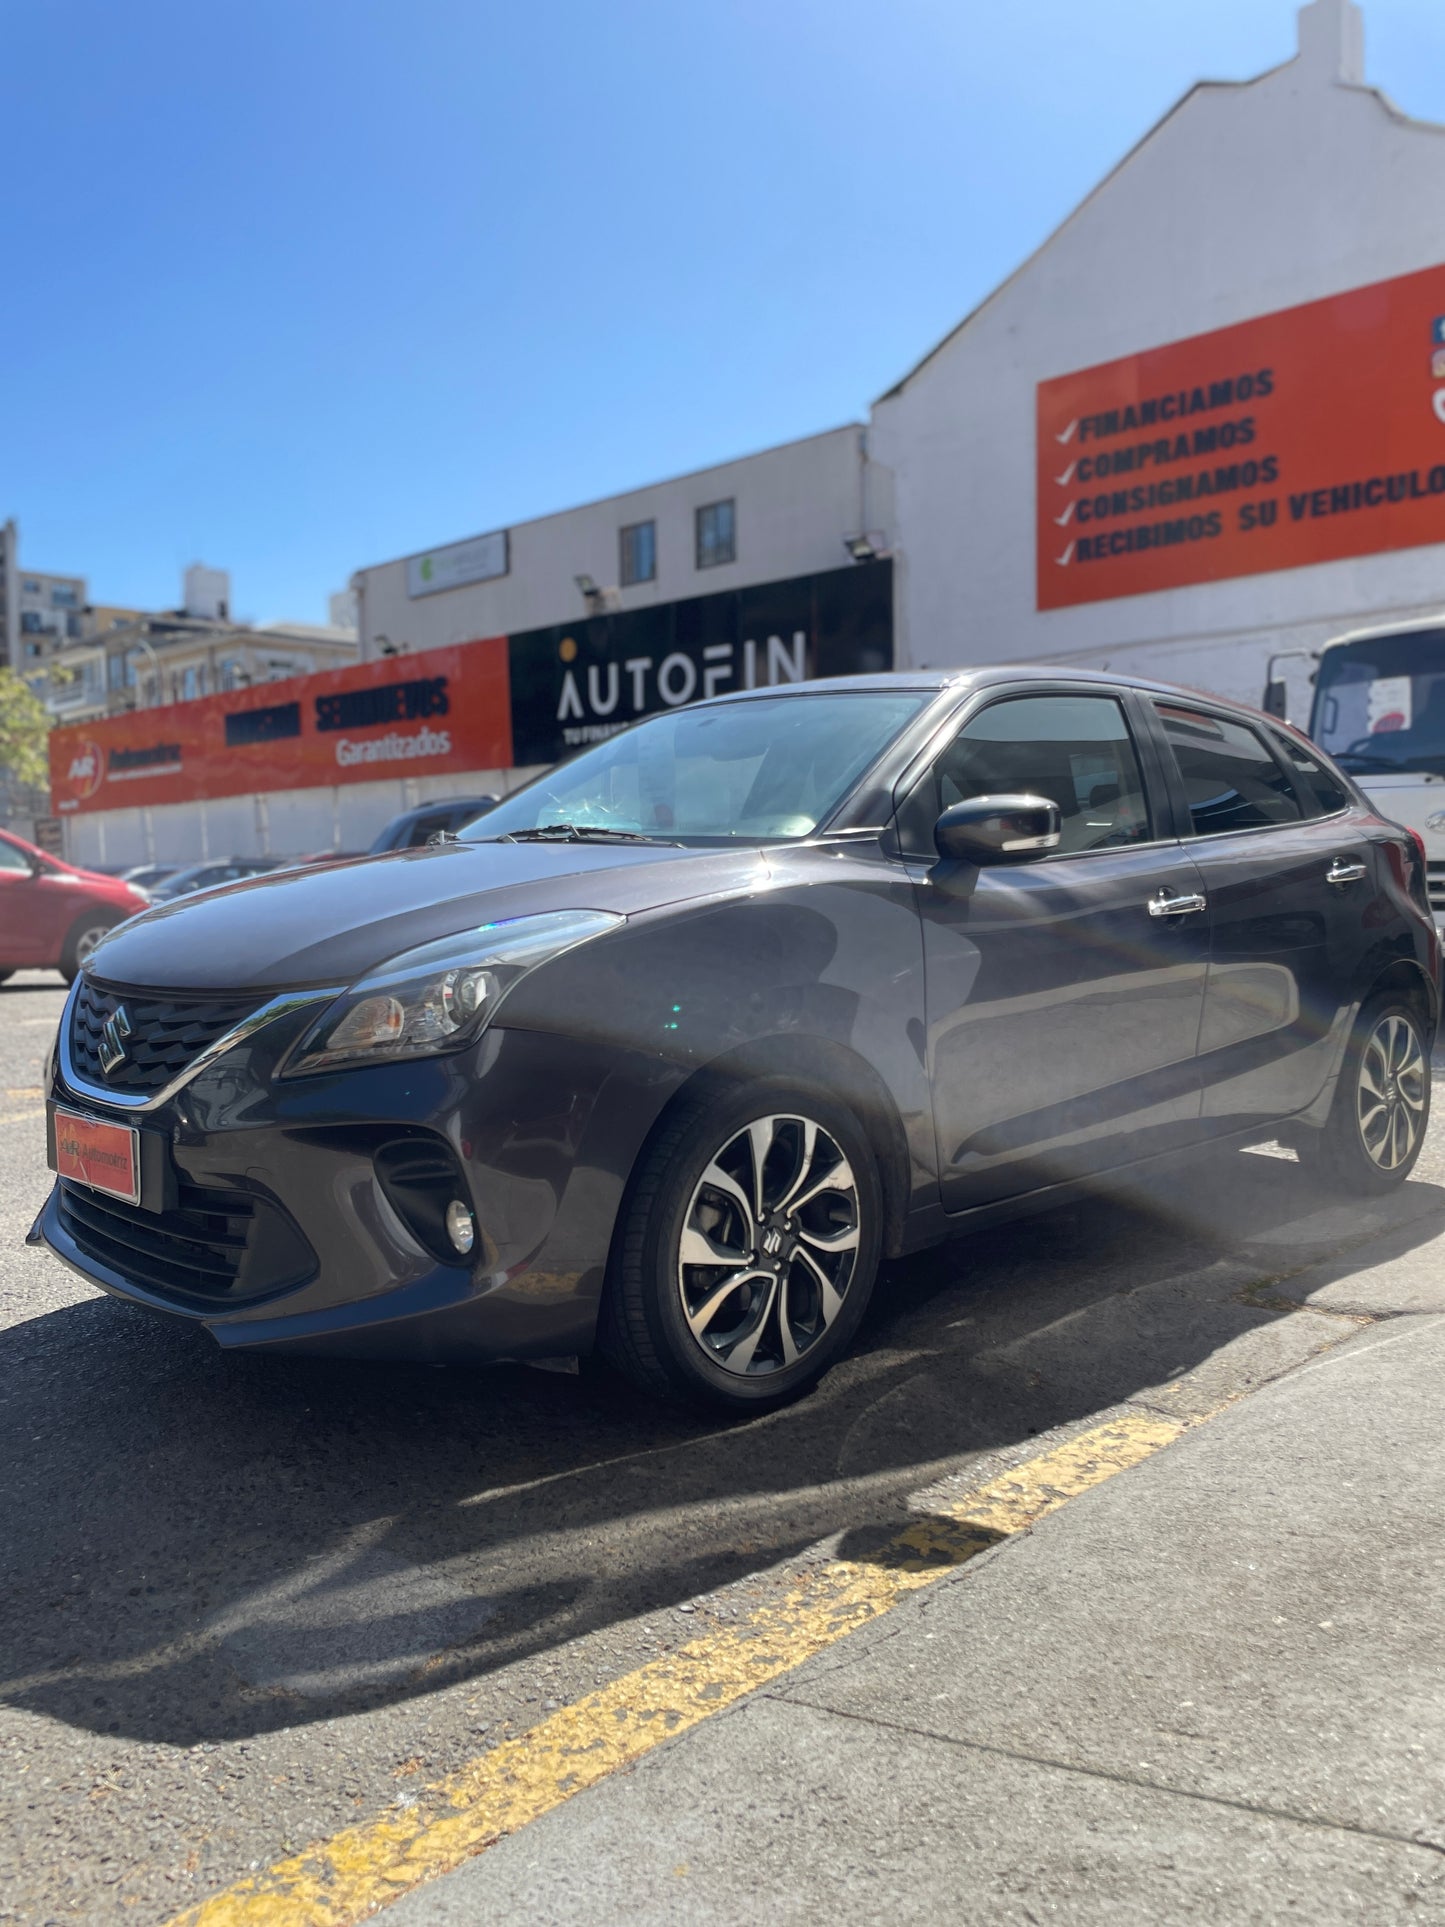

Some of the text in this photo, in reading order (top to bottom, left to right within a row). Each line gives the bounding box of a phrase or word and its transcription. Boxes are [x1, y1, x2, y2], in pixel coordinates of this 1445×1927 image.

[1078, 369, 1274, 442] FINANCIAMOS
[1077, 417, 1256, 482] COMPRAMOS
[1076, 456, 1278, 523] CONSIGNAMOS
[1076, 511, 1222, 562] RECIBIMOS
[1239, 500, 1277, 531] SU
[557, 631, 805, 720] AUTOFIN
[336, 726, 452, 767] Garantizados
